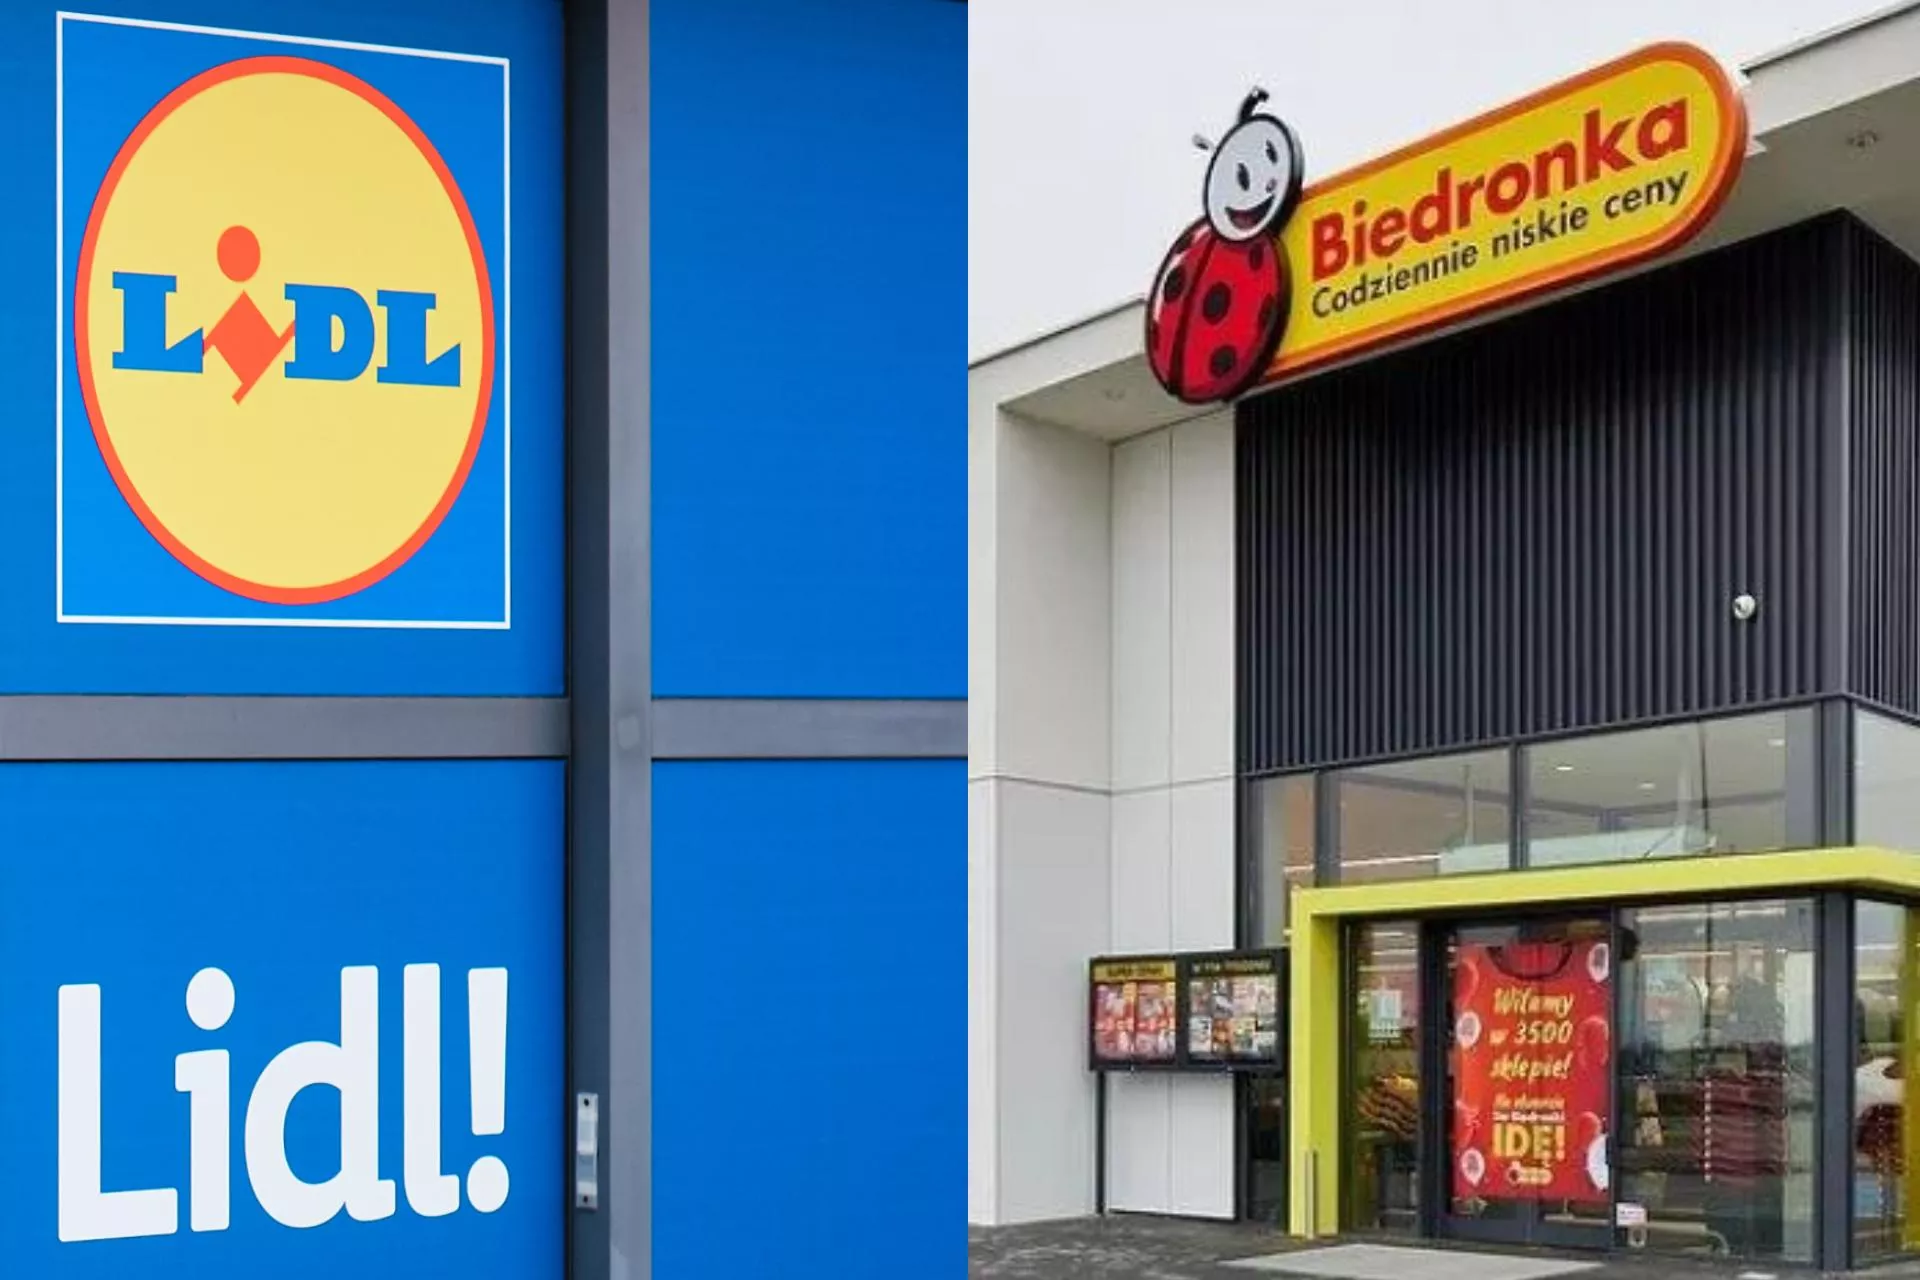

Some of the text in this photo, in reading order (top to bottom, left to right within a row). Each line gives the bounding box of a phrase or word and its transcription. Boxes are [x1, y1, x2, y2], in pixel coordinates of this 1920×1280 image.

[1311, 97, 1688, 281] Biedronka
[1312, 171, 1688, 318] Codziennie niskie ceny
[1493, 986, 1574, 1017] Witamy
[1513, 1020, 1573, 1044] 3500
[57, 962, 510, 1243] Lidl!
[1489, 1052, 1572, 1082] sklepie!
